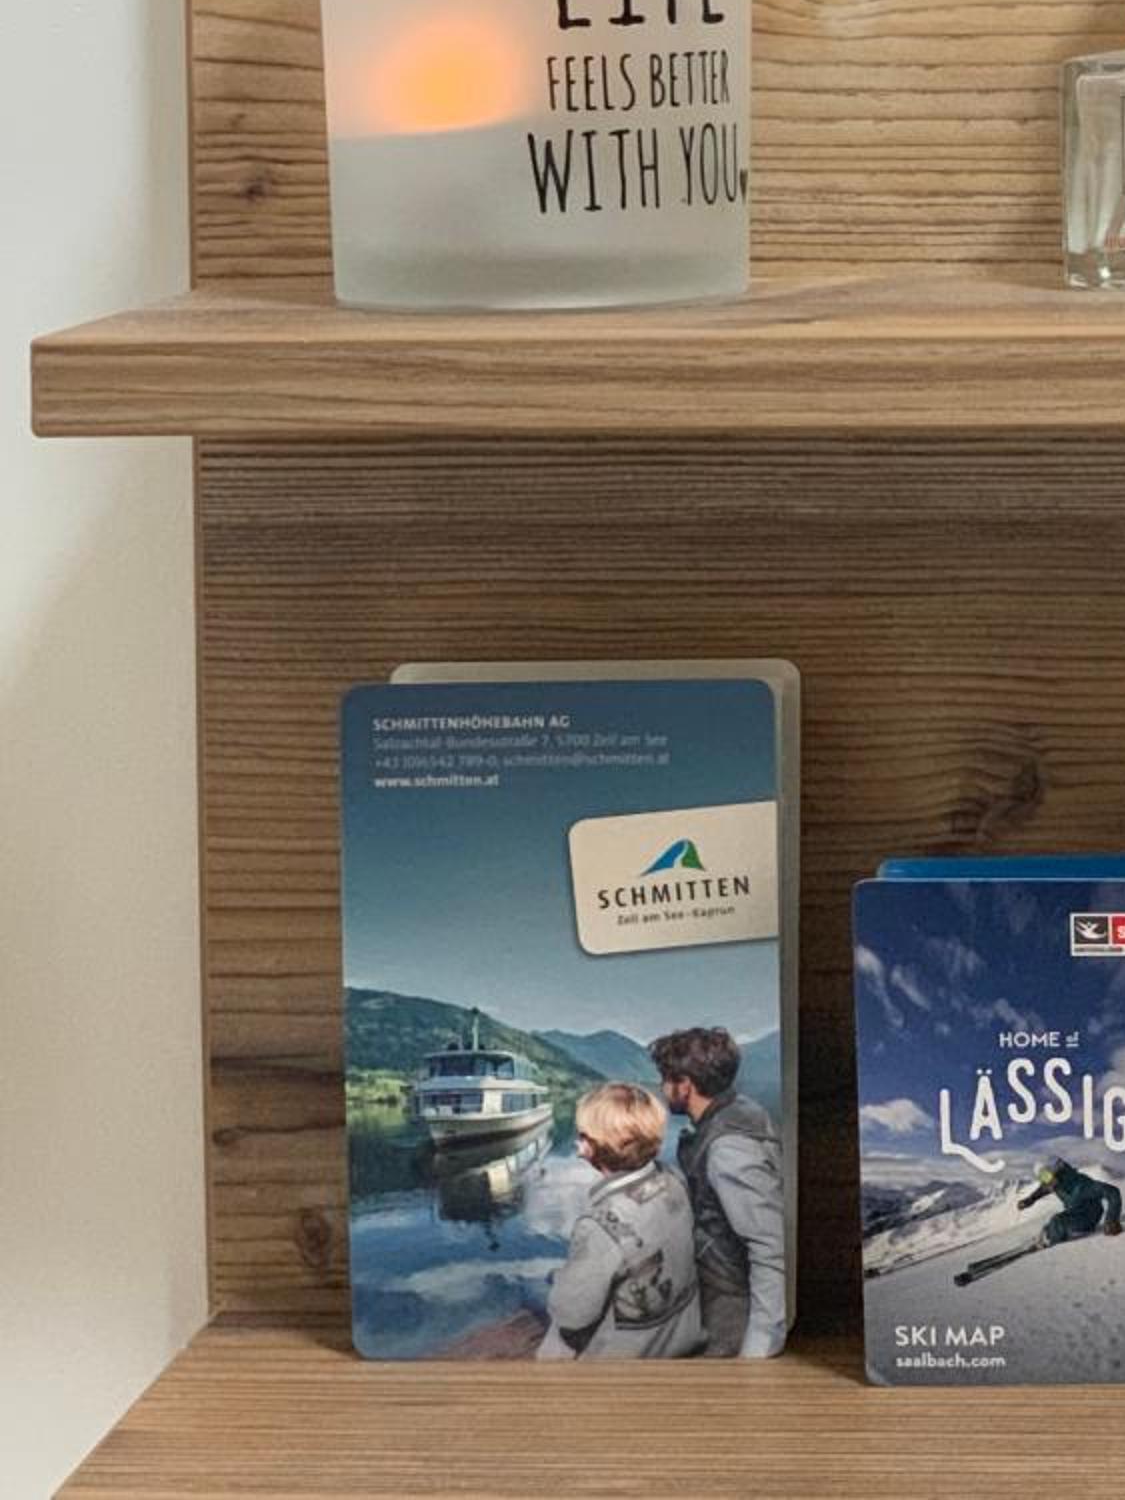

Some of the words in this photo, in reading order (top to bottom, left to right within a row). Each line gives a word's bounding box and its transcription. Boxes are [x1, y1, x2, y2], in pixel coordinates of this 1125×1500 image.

[547, 52, 636, 112] FEELS
[649, 49, 731, 108] BETTER
[527, 128, 661, 214] WITH
[679, 122, 738, 206] YOU
[373, 714, 545, 731] SCHMITTENHÖHEBAHN
[549, 714, 570, 728] AG
[374, 773, 499, 788] www.schmitten.at
[598, 875, 750, 909] SCHMITTEN
[617, 914, 638, 925] Zell
[643, 914, 660, 923] am
[999, 1031, 1061, 1048] HOME
[895, 1326, 937, 1347] SKI
[945, 1326, 1005, 1347] MAP
[896, 1352, 1006, 1368] saalbach.com
